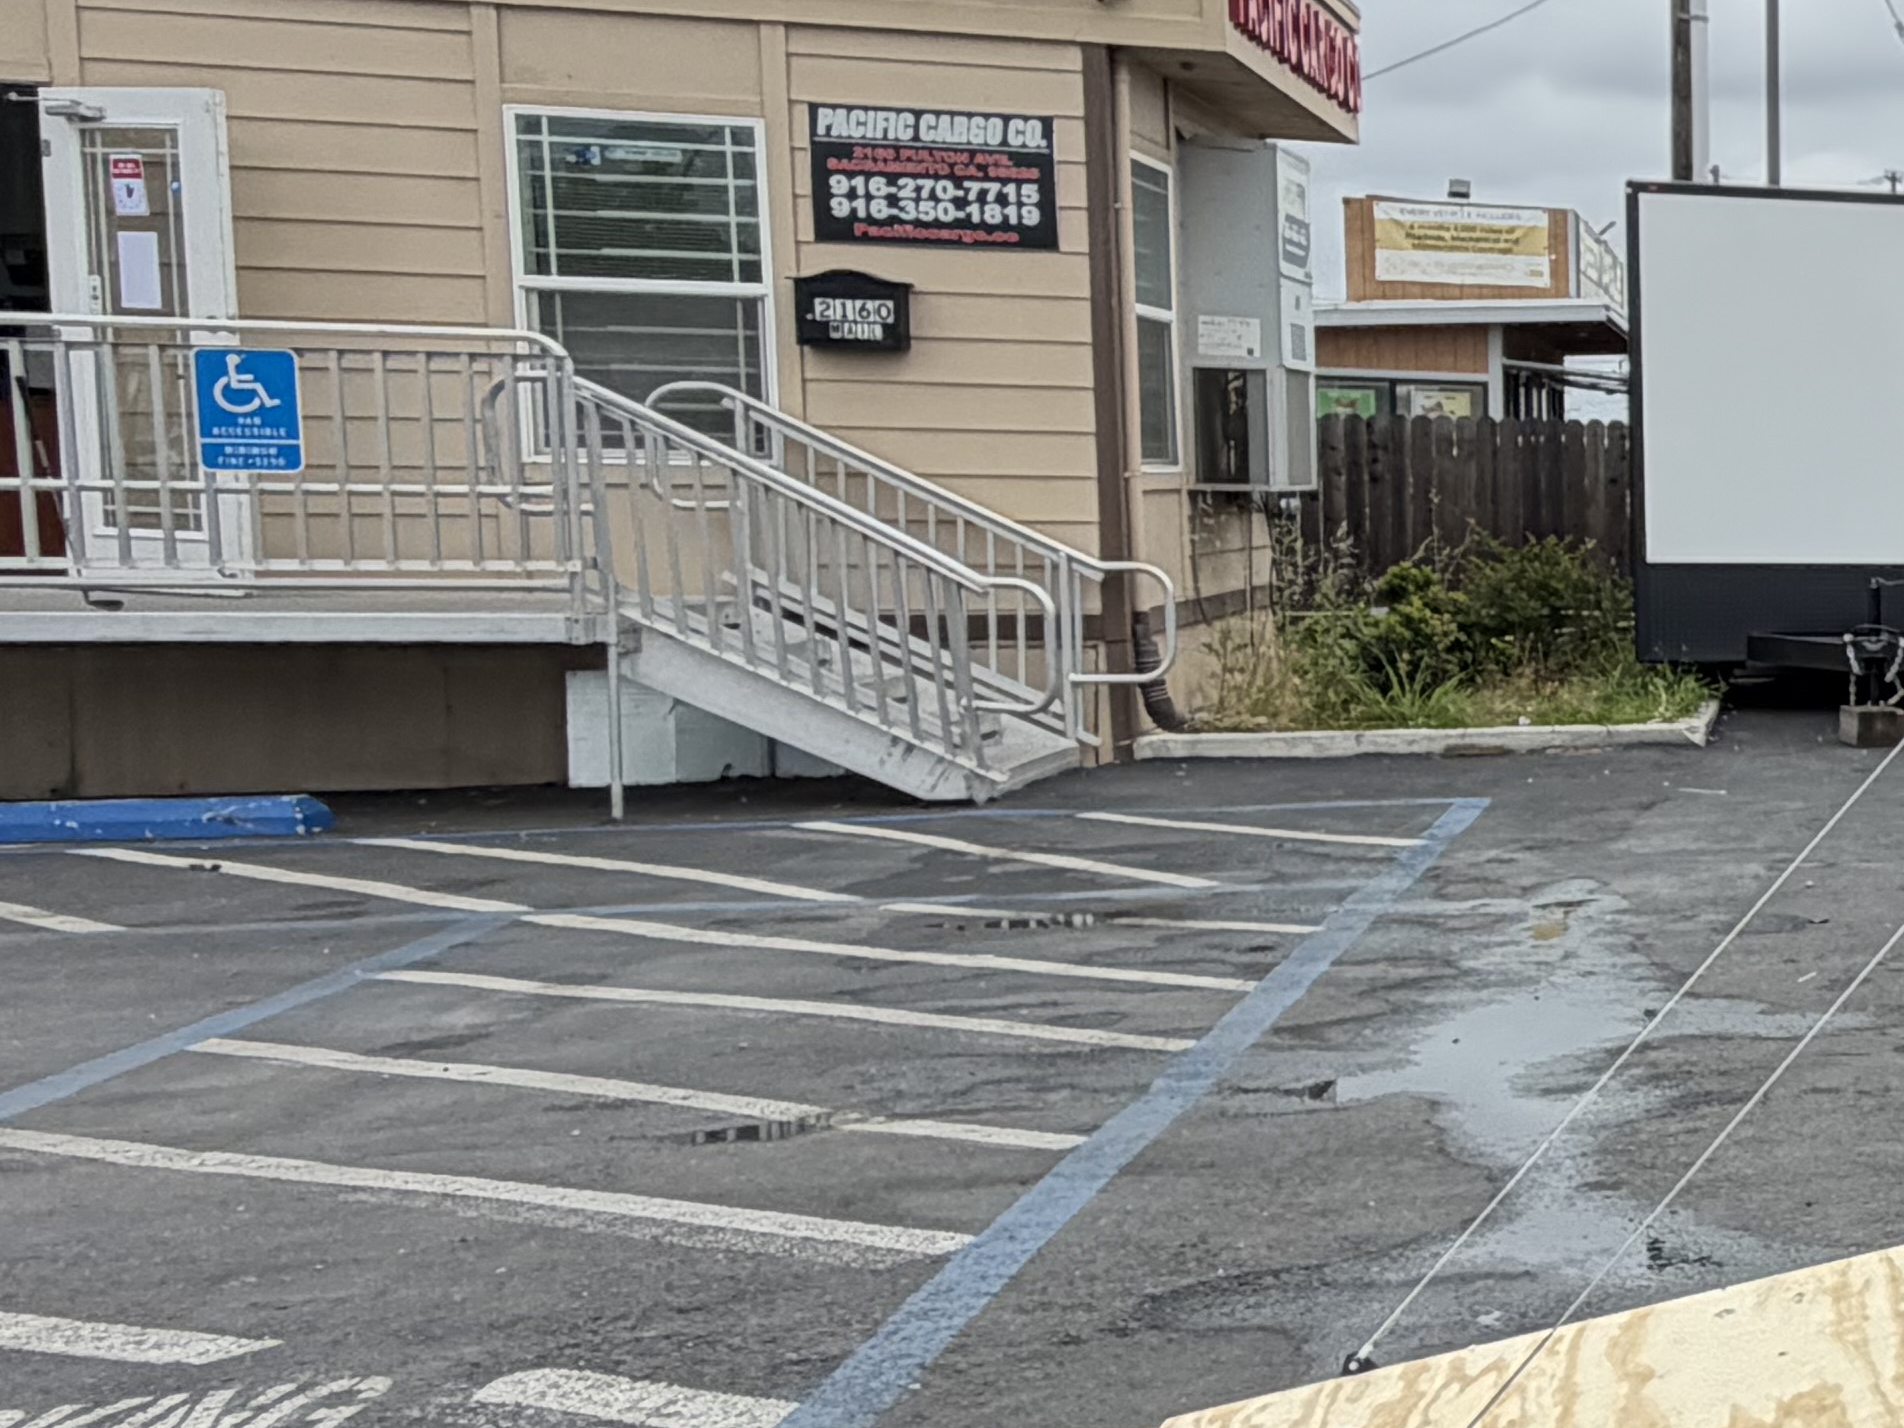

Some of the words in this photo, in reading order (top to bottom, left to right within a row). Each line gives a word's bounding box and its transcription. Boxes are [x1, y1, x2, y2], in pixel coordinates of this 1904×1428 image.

[816, 106, 916, 142] PACIFIC
[918, 112, 1004, 146] CARGO
[1006, 118, 1048, 149] CO.
[828, 173, 1041, 205] 916-270-7715
[829, 196, 1042, 227] 916-350-1819
[817, 302, 891, 322] 2160
